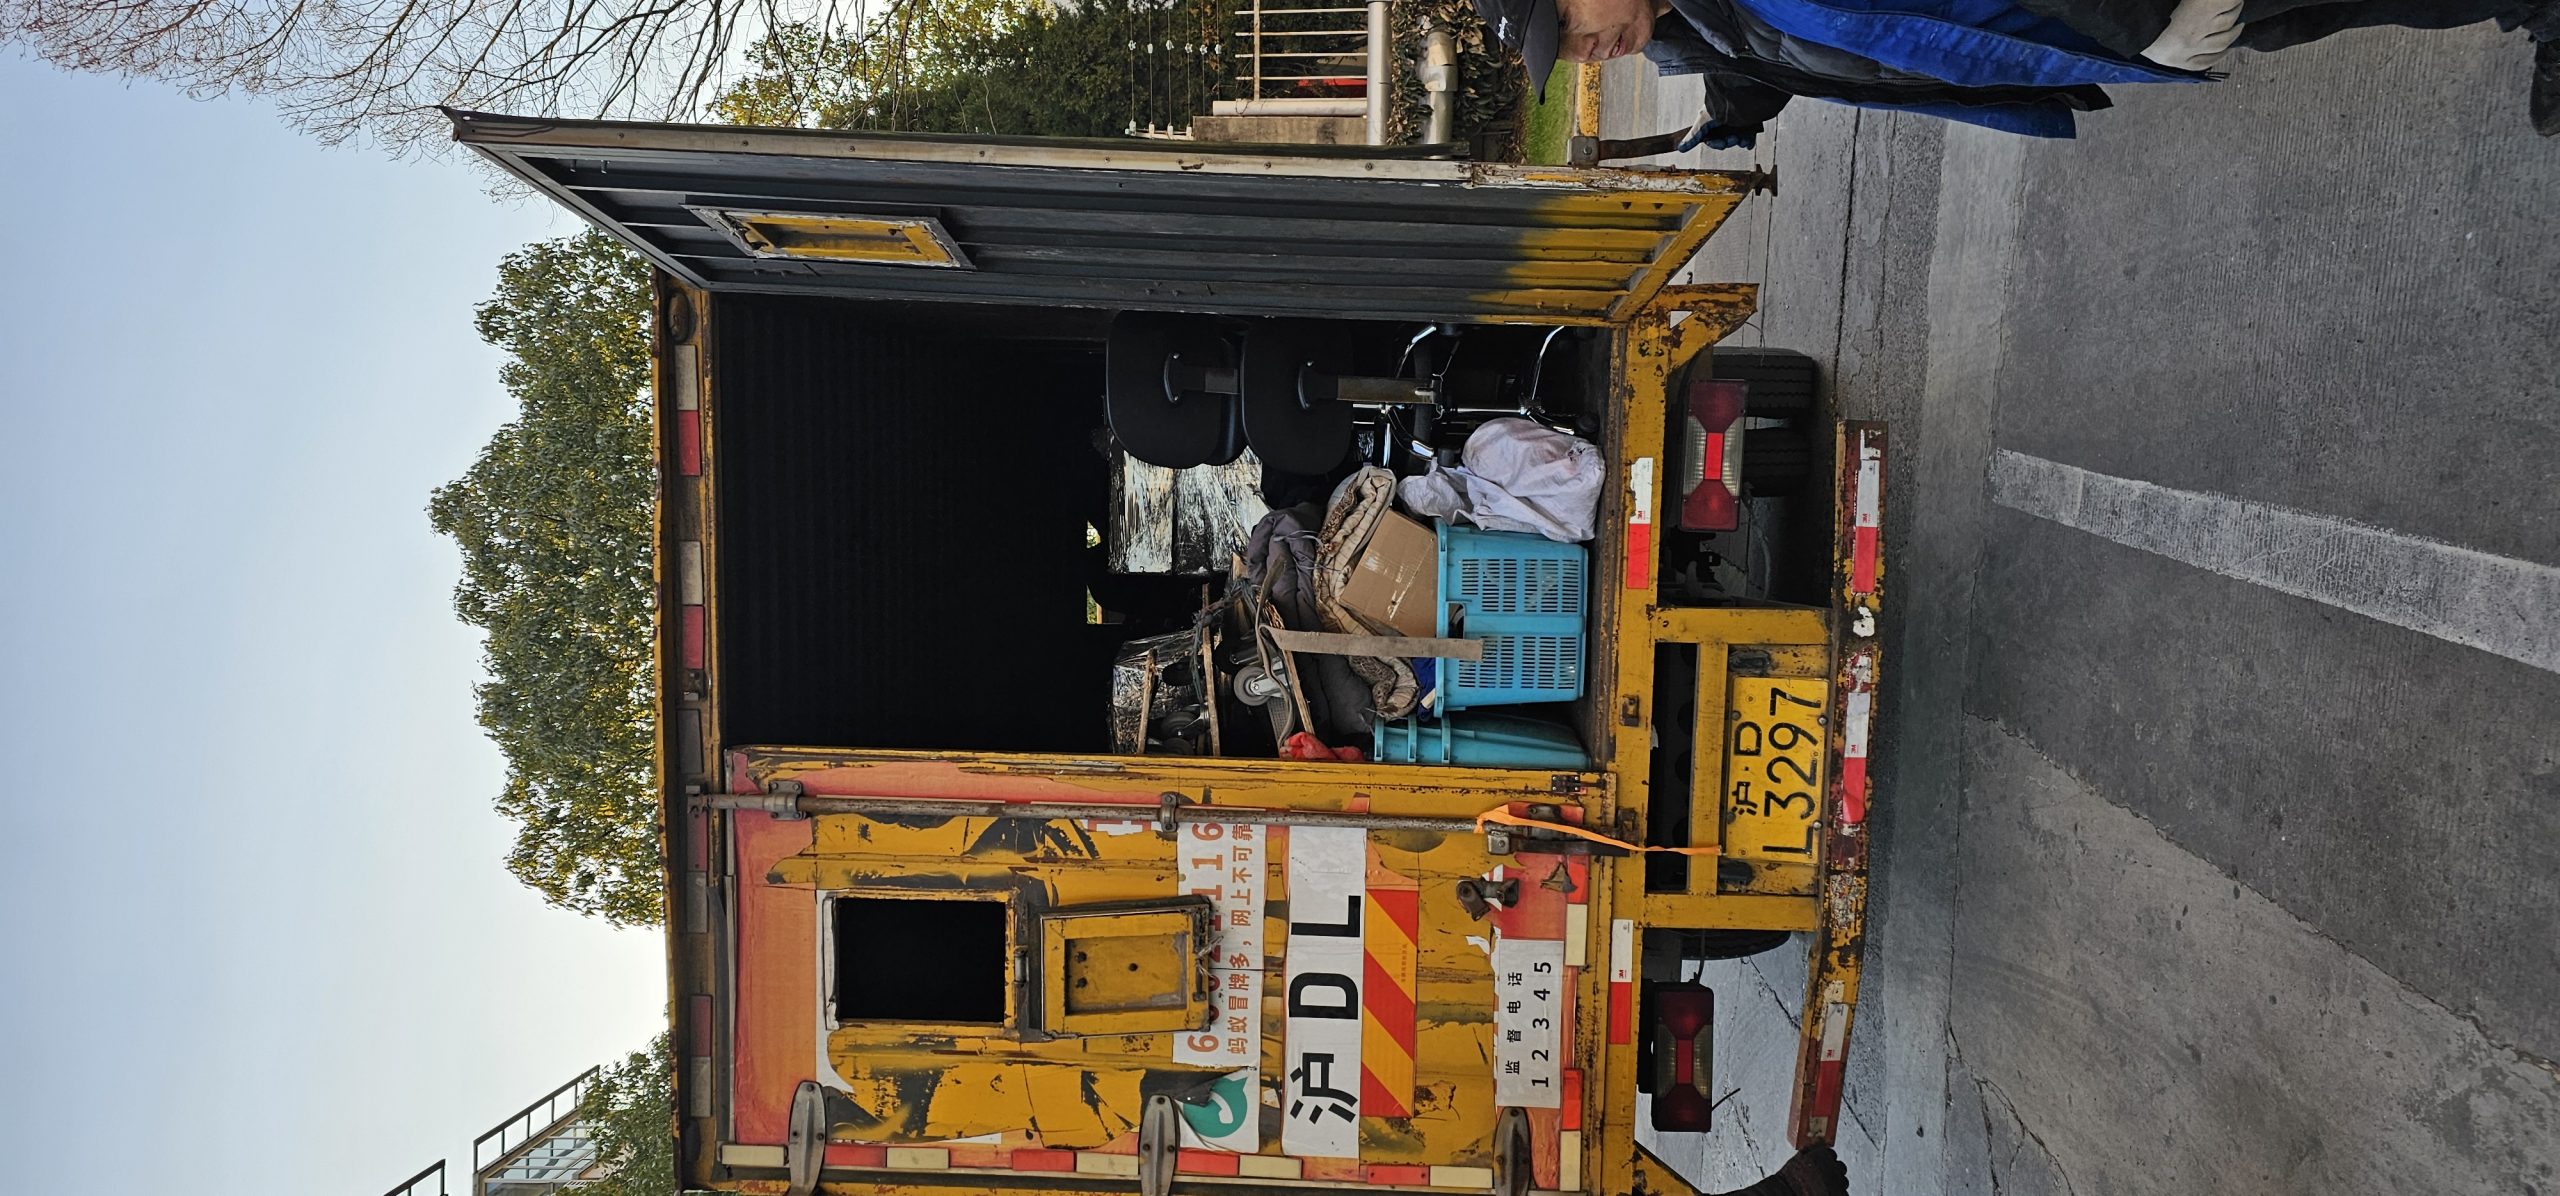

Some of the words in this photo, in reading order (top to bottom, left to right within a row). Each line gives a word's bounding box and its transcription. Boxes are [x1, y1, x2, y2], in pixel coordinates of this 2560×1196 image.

[1762, 687, 1821, 855] L3297
[1505, 972, 1522, 1075] 监督电话
[1531, 962, 1551, 1088] 12345
